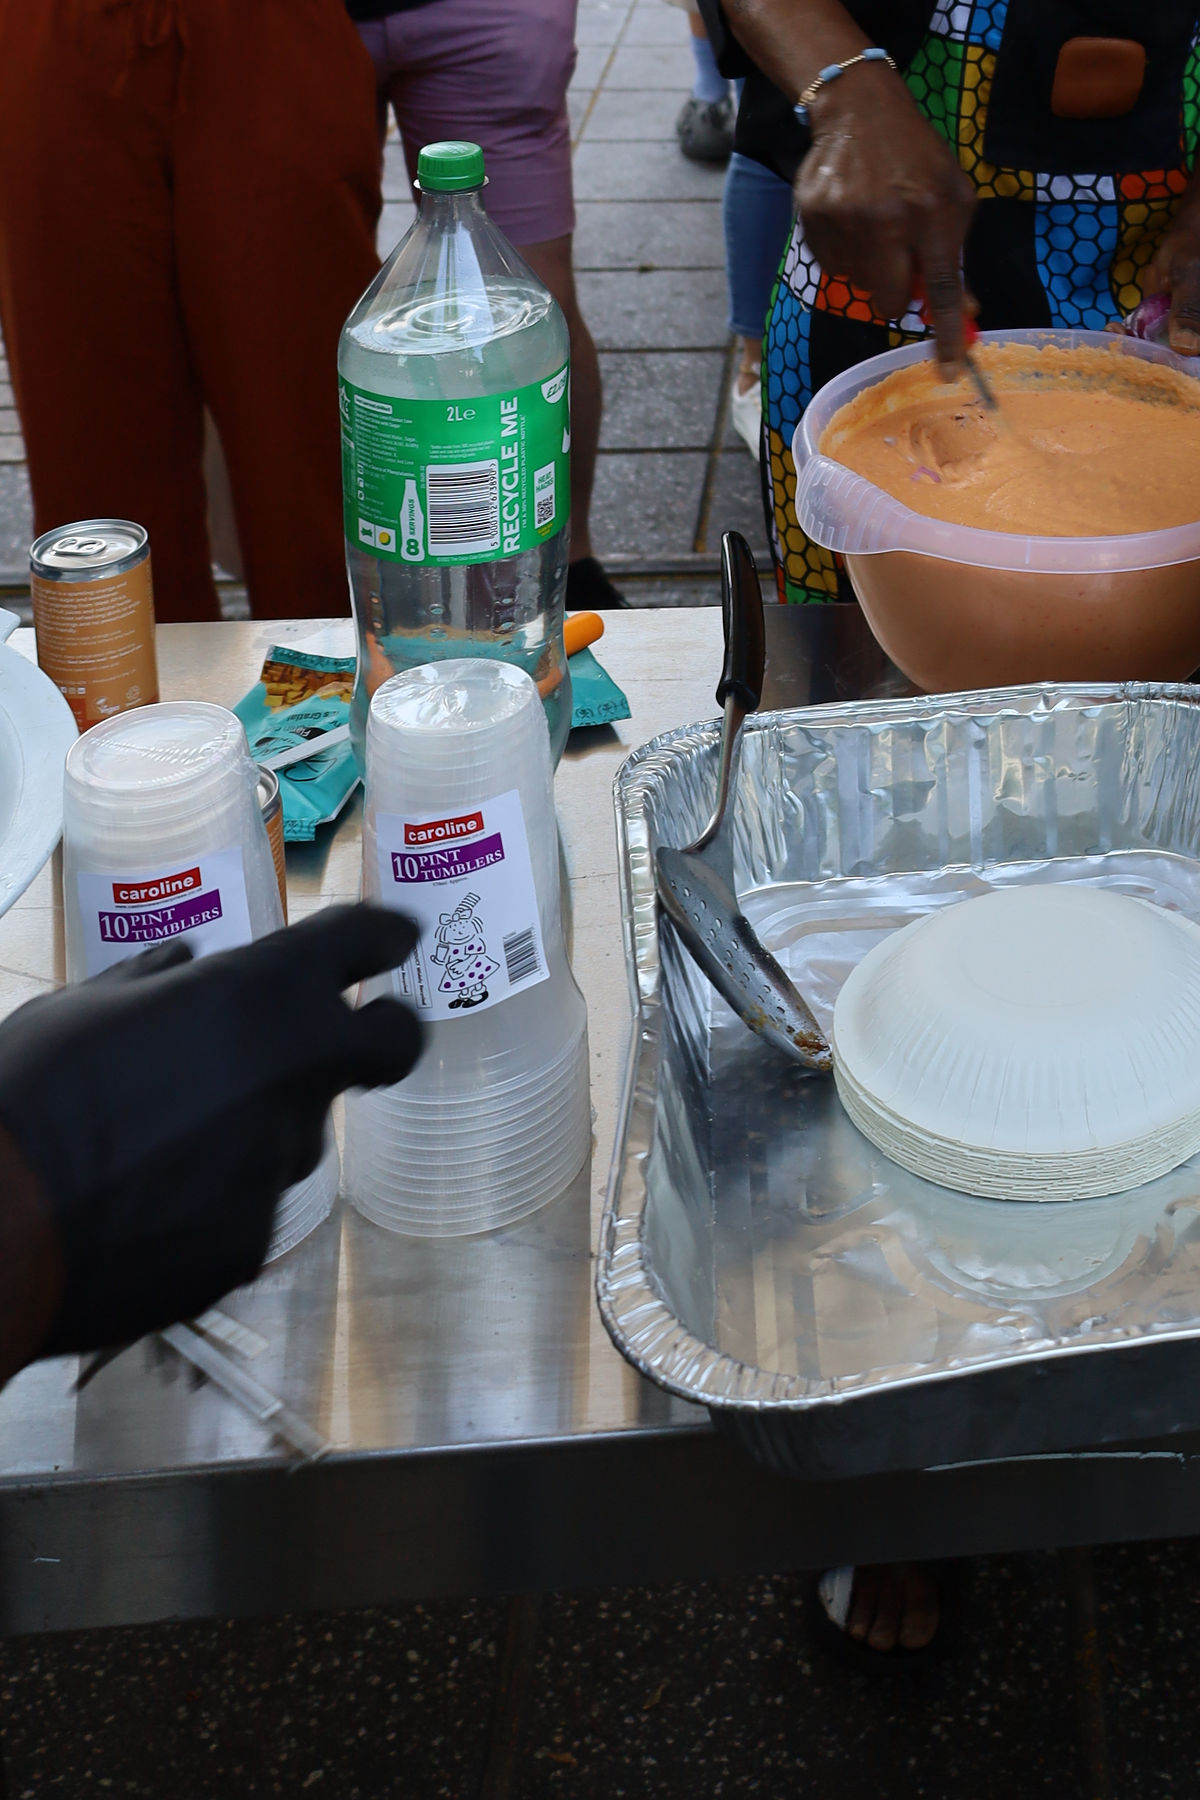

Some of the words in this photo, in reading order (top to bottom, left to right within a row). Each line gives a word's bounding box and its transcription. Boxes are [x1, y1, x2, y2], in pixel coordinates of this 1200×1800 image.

[500, 397, 518, 438] ME
[501, 441, 521, 553] RECYCLE
[406, 538, 419, 556] 8
[408, 819, 477, 842] caroline
[393, 855, 419, 880] 10
[420, 849, 461, 868] PINT
[421, 849, 502, 881] TUMBLERS
[119, 875, 194, 900] caroline
[100, 914, 130, 939] 10
[130, 907, 176, 927] PINT
[132, 906, 220, 940] TUMBLERS
